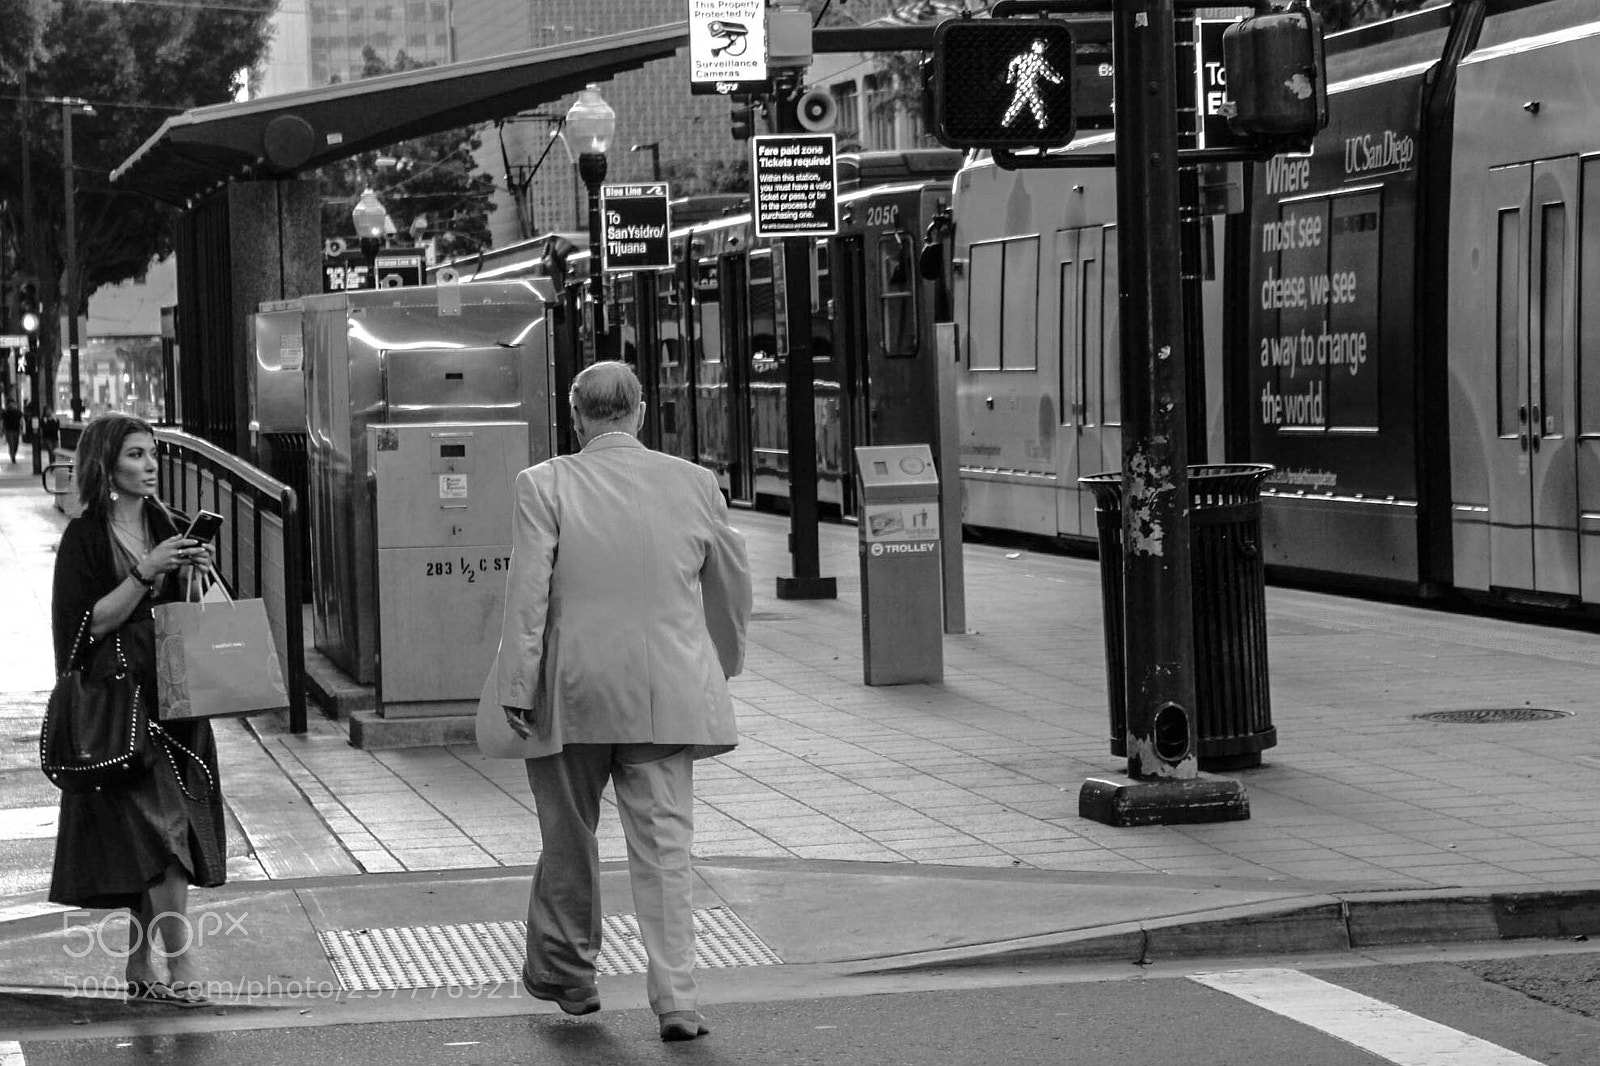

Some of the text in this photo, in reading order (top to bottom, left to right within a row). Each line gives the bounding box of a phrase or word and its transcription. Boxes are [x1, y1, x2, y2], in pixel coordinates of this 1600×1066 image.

[718, 1, 760, 9] Property
[694, 10, 756, 19] Protected by
[695, 60, 758, 69] Surveillance
[695, 70, 740, 78] Cameras
[758, 145, 824, 157] Fare paid zone
[759, 155, 831, 168] Tickets required
[760, 173, 821, 182] Within this station,
[1265, 156, 1310, 195] Where
[605, 187, 642, 197] Blue Line
[760, 184, 773, 193] you
[774, 183, 791, 191] must
[792, 182, 809, 191] have
[815, 181, 832, 190] valid
[760, 192, 780, 201] ticket
[780, 193, 788, 201] or
[808, 192, 816, 200] or
[816, 191, 827, 200] be
[760, 200, 816, 211] in the process of
[607, 210, 621, 225] To
[761, 211, 798, 221] purchasing
[1263, 212, 1322, 253] most see
[607, 241, 647, 257] Tijuana
[1261, 266, 1356, 312] cheese, we see
[1260, 320, 1367, 379] a way to change
[1261, 380, 1326, 425] the world.
[885, 542, 935, 554] TROLLEY
[426, 562, 453, 576] 283
[479, 558, 487, 572] C
[494, 557, 511, 571] ST
